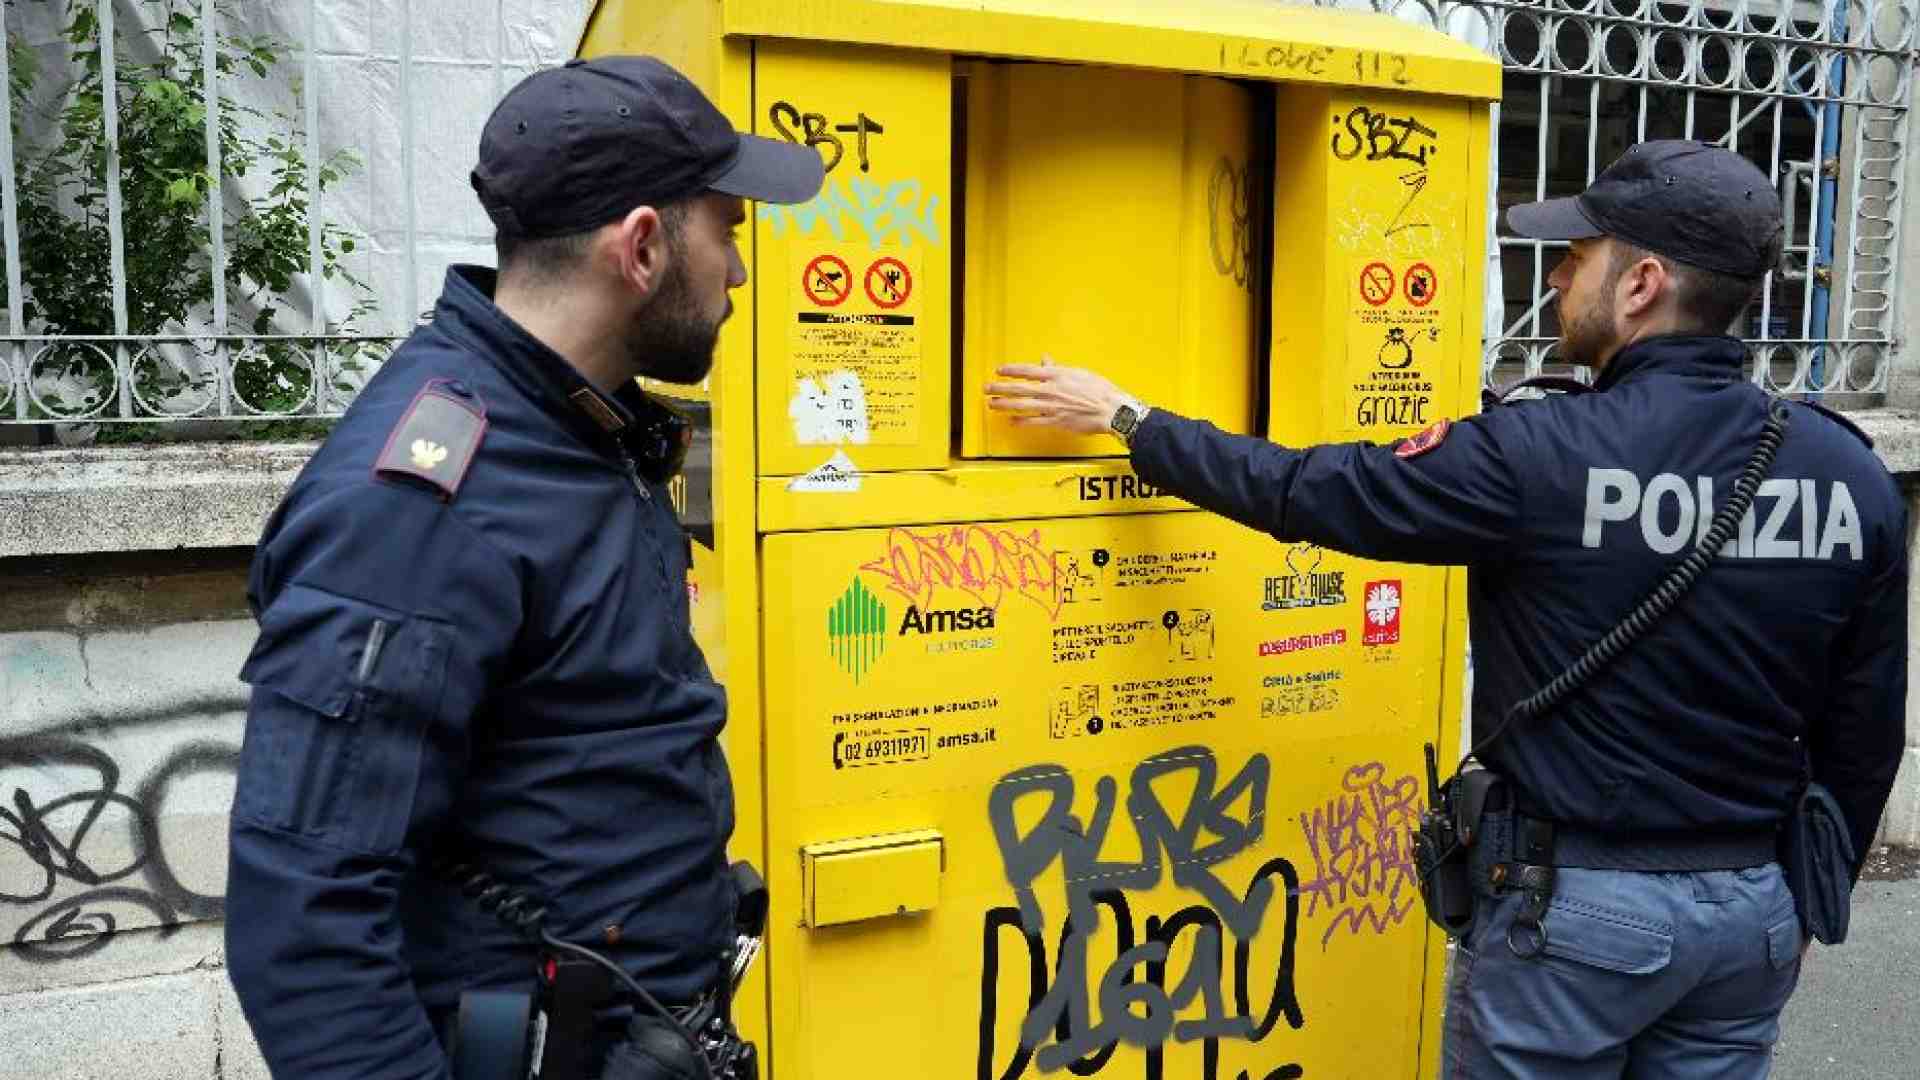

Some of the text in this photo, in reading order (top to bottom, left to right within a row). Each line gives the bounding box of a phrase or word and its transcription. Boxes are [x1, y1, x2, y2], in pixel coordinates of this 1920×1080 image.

[1357, 394, 1430, 427] Grazie
[1581, 466, 1865, 561] POLIZIA
[899, 603, 995, 636] Amsa
[845, 736, 926, 761] 02 69311971
[937, 727, 997, 749] amsa.it
